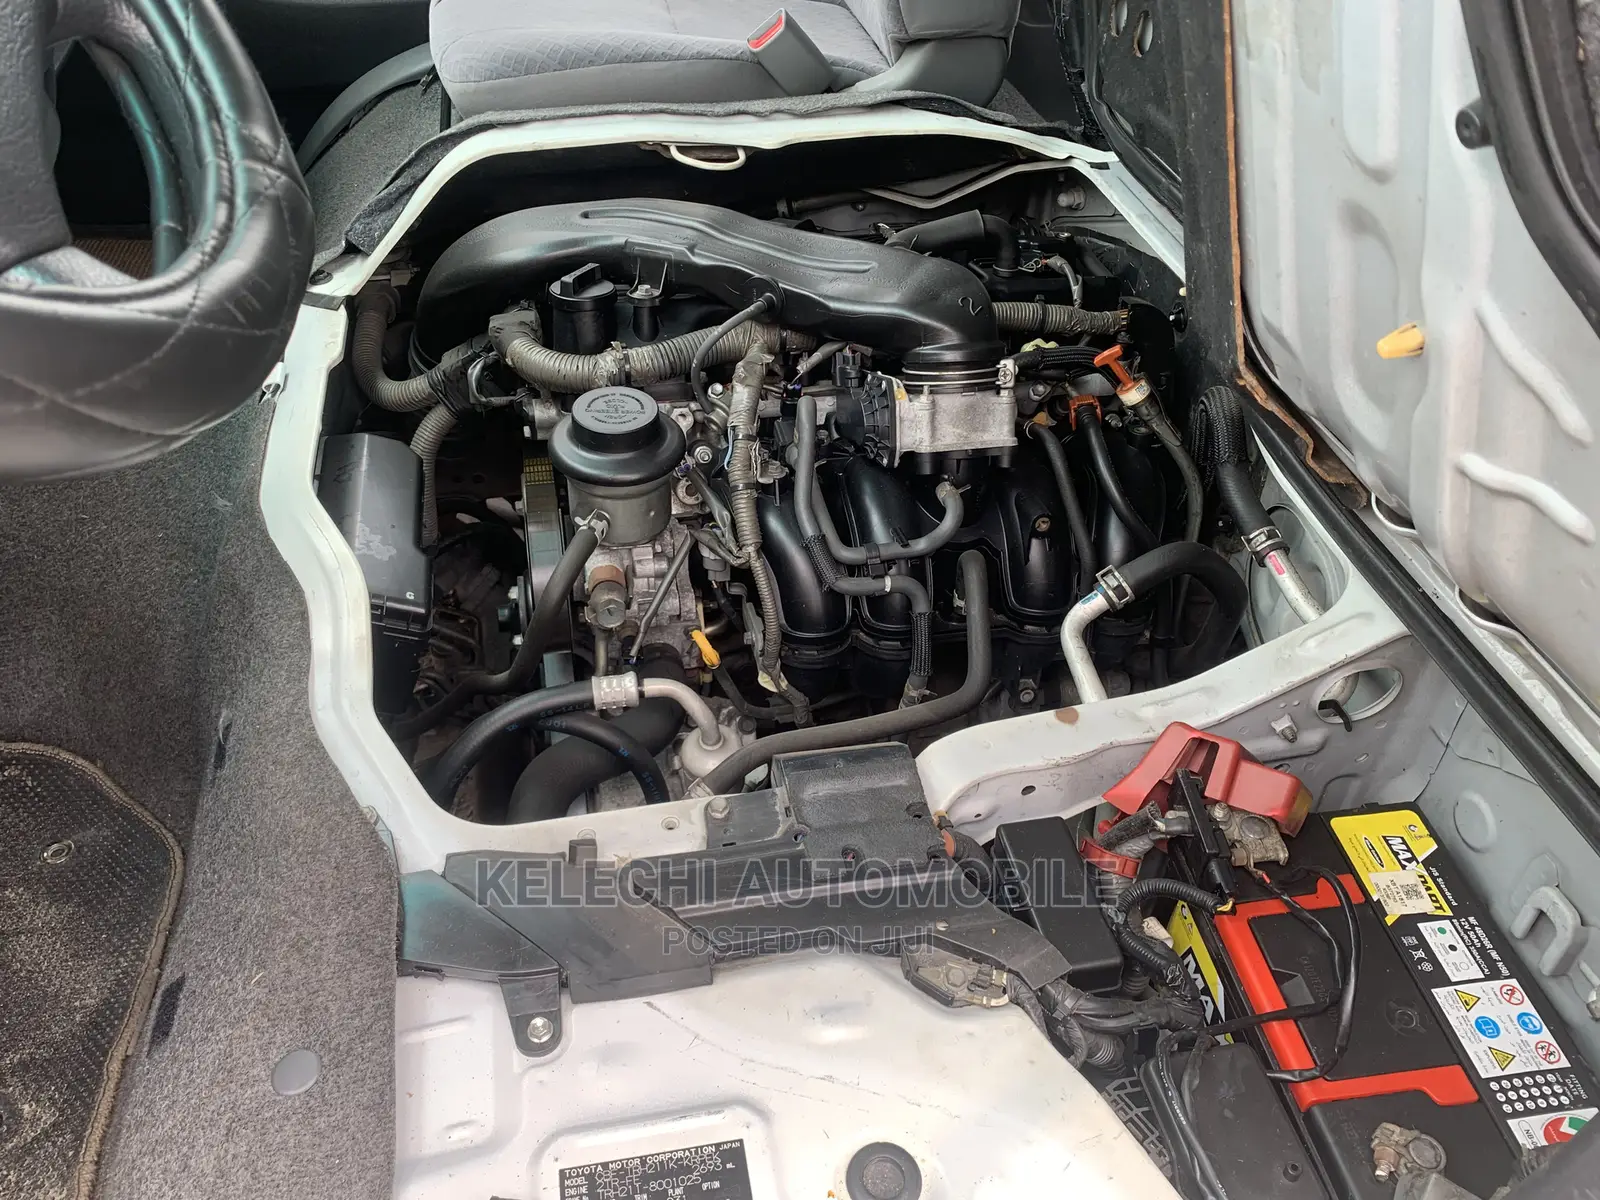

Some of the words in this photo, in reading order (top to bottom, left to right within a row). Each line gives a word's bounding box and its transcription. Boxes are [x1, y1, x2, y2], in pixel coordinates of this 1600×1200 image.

[1385, 837, 1421, 872] MAX
[1436, 878, 1458, 906] Standard
[1565, 1079, 1579, 1096] DATE
[1570, 1074, 1588, 1100] FITTING
[564, 1165, 603, 1178] TOYOTA
[609, 1158, 640, 1170] MOTOR
[646, 1145, 716, 1164] CORPORATION
[719, 1141, 740, 1150] JAPAN
[564, 1186, 588, 1197] ENGINE
[692, 1161, 722, 1176] 2693
[564, 1176, 588, 1187] MODEL
[668, 1187, 684, 1196] PLANT
[701, 1181, 720, 1191] OPTION
